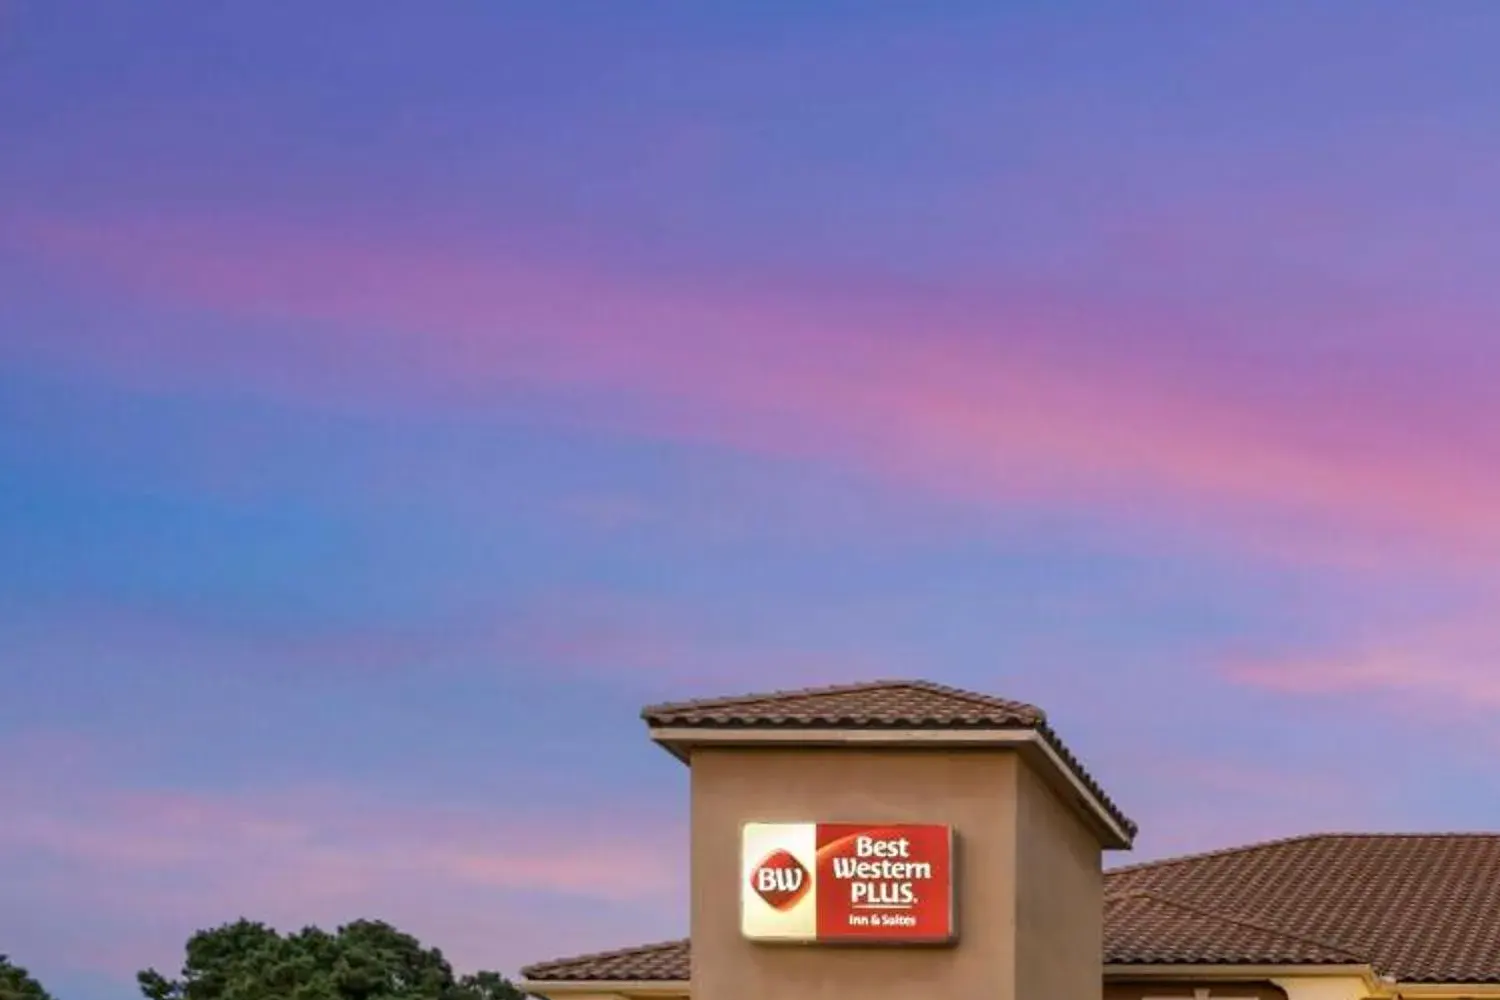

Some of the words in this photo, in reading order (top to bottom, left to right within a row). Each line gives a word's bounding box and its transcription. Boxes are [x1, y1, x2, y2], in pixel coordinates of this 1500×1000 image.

[856, 836, 910, 857] Best
[758, 867, 803, 891] BW
[832, 857, 931, 879] Western
[851, 882, 914, 904] PLUS
[849, 914, 869, 925] Inn
[871, 914, 880, 925] &
[882, 914, 916, 926] Suites
